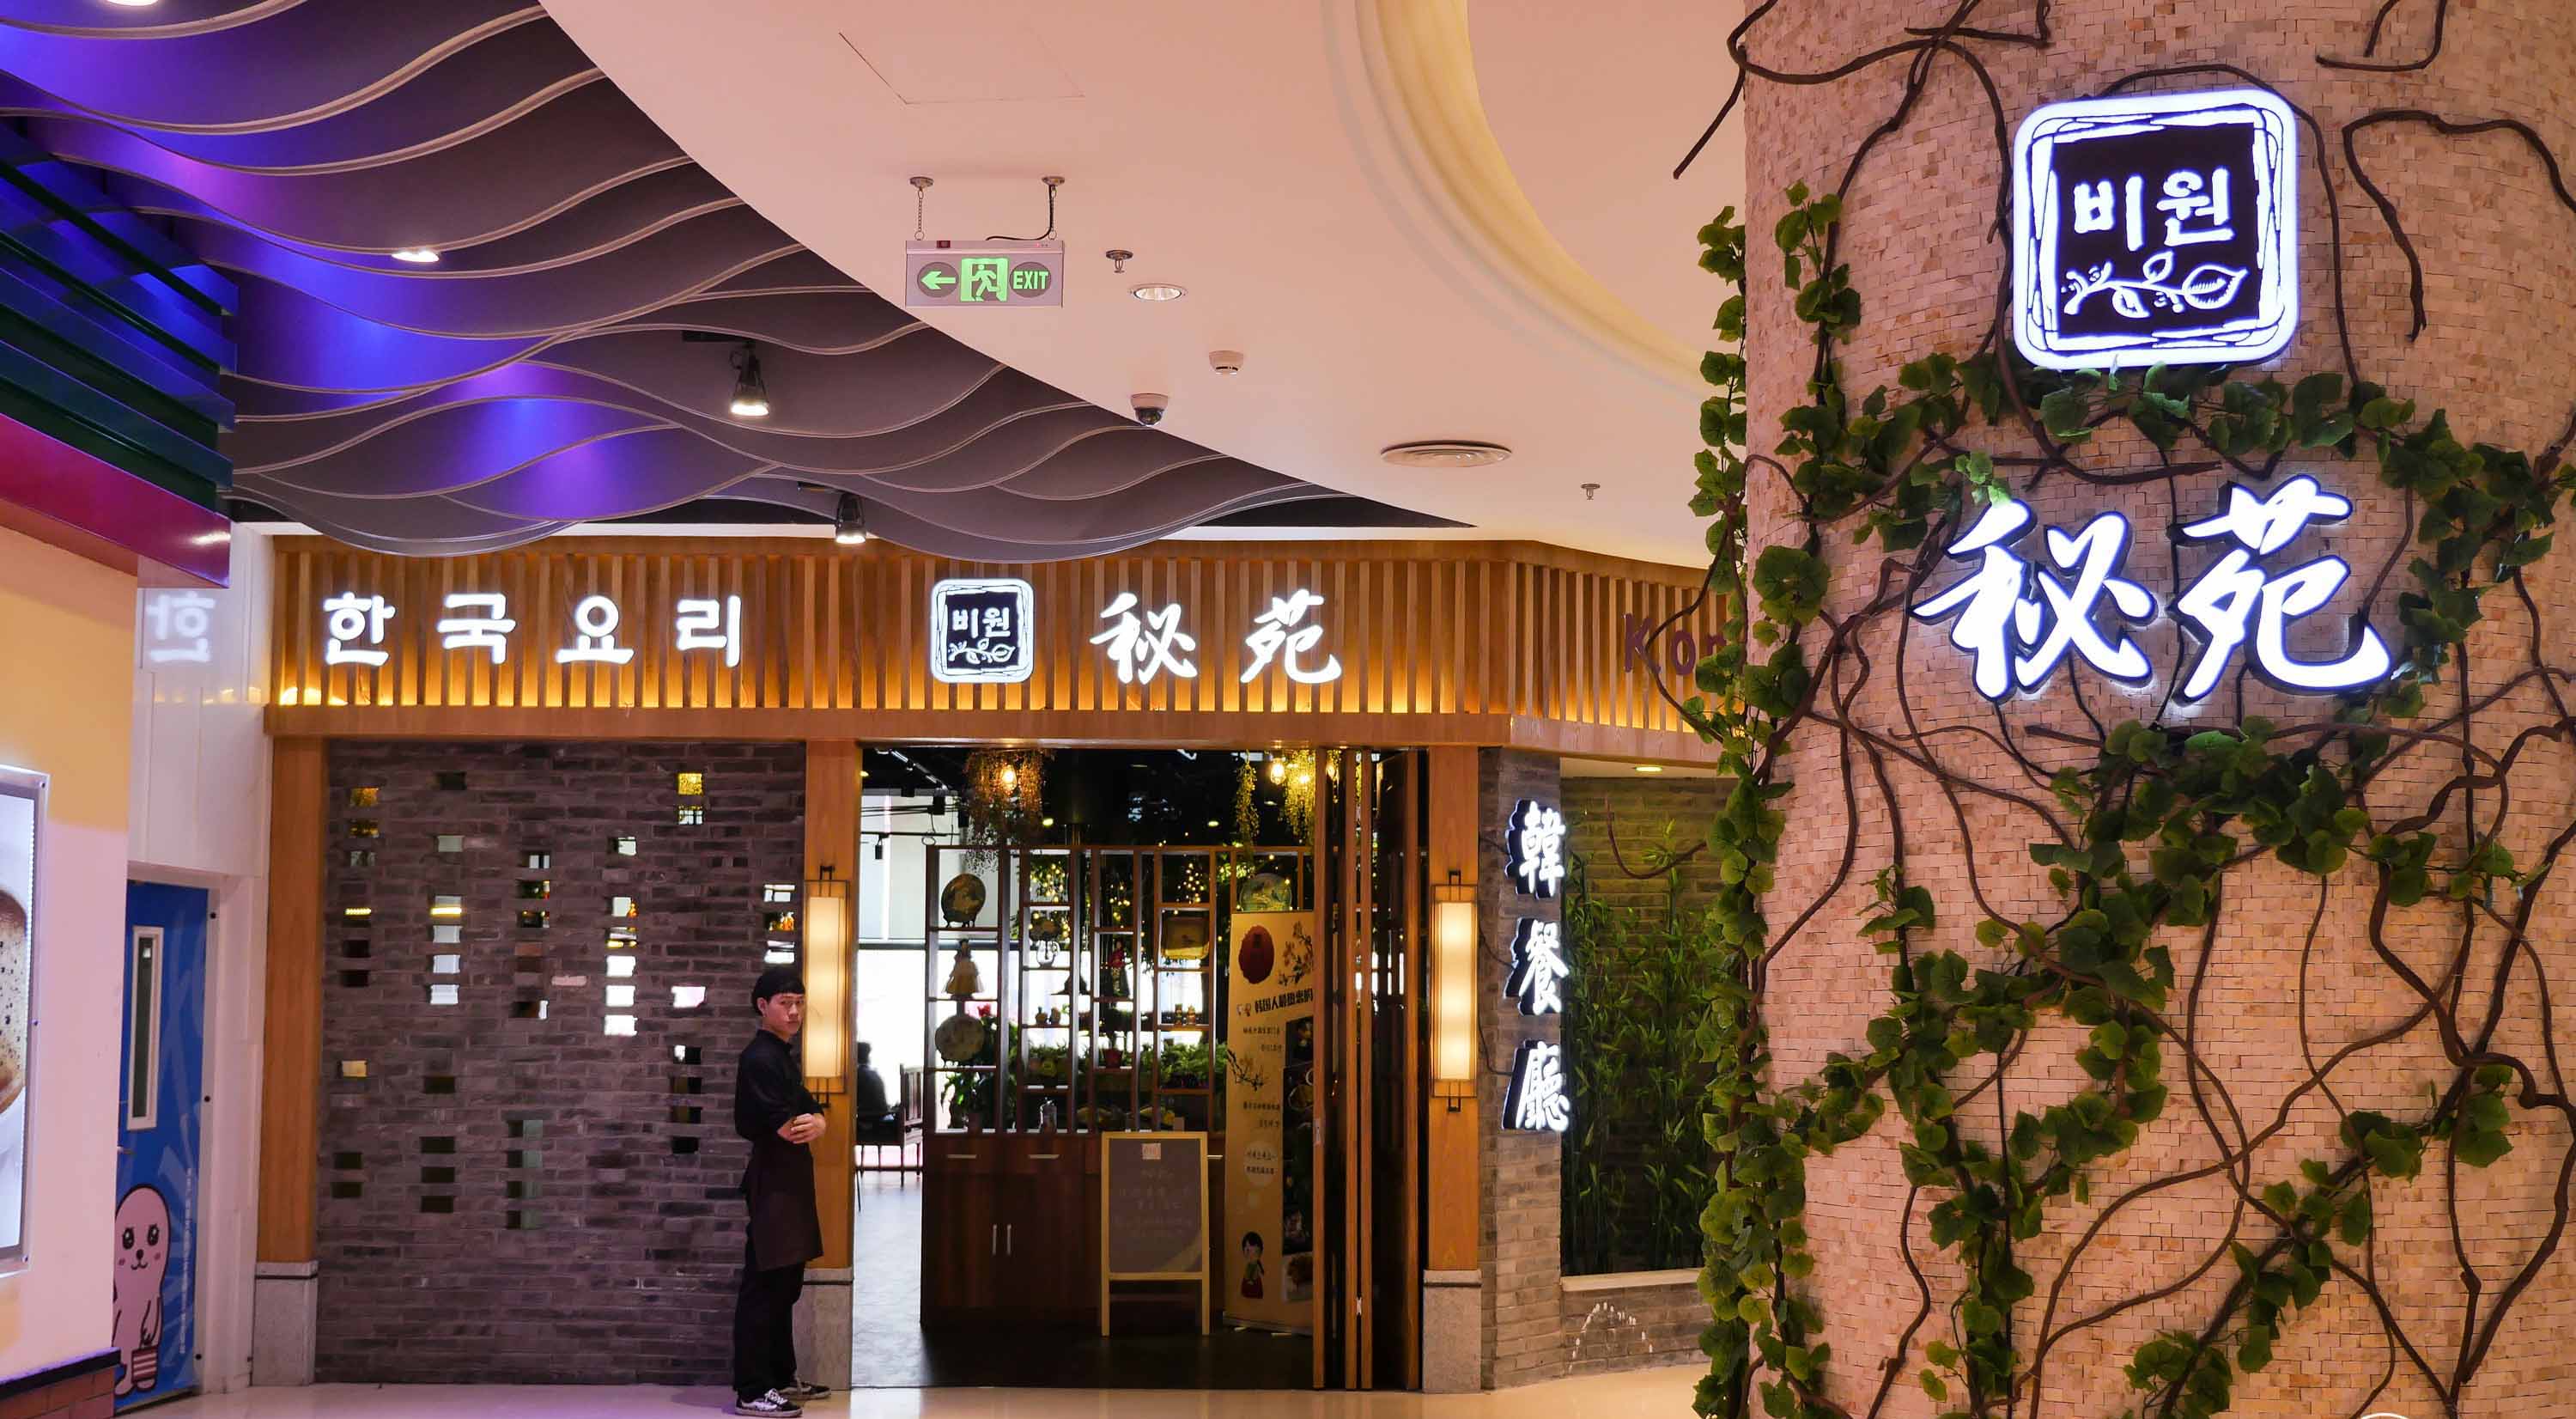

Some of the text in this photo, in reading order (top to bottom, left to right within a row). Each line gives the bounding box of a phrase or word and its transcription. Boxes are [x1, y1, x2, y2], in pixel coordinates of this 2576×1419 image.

[2070, 167, 2237, 253] 비원
[1012, 271, 1049, 289] EXIT
[322, 591, 742, 667] 한국요리
[952, 606, 1012, 639] 비원
[1911, 475, 2392, 706] 秘苑
[1090, 588, 1342, 685] 秘苑
[1516, 800, 1570, 1132] 韓餐廳
